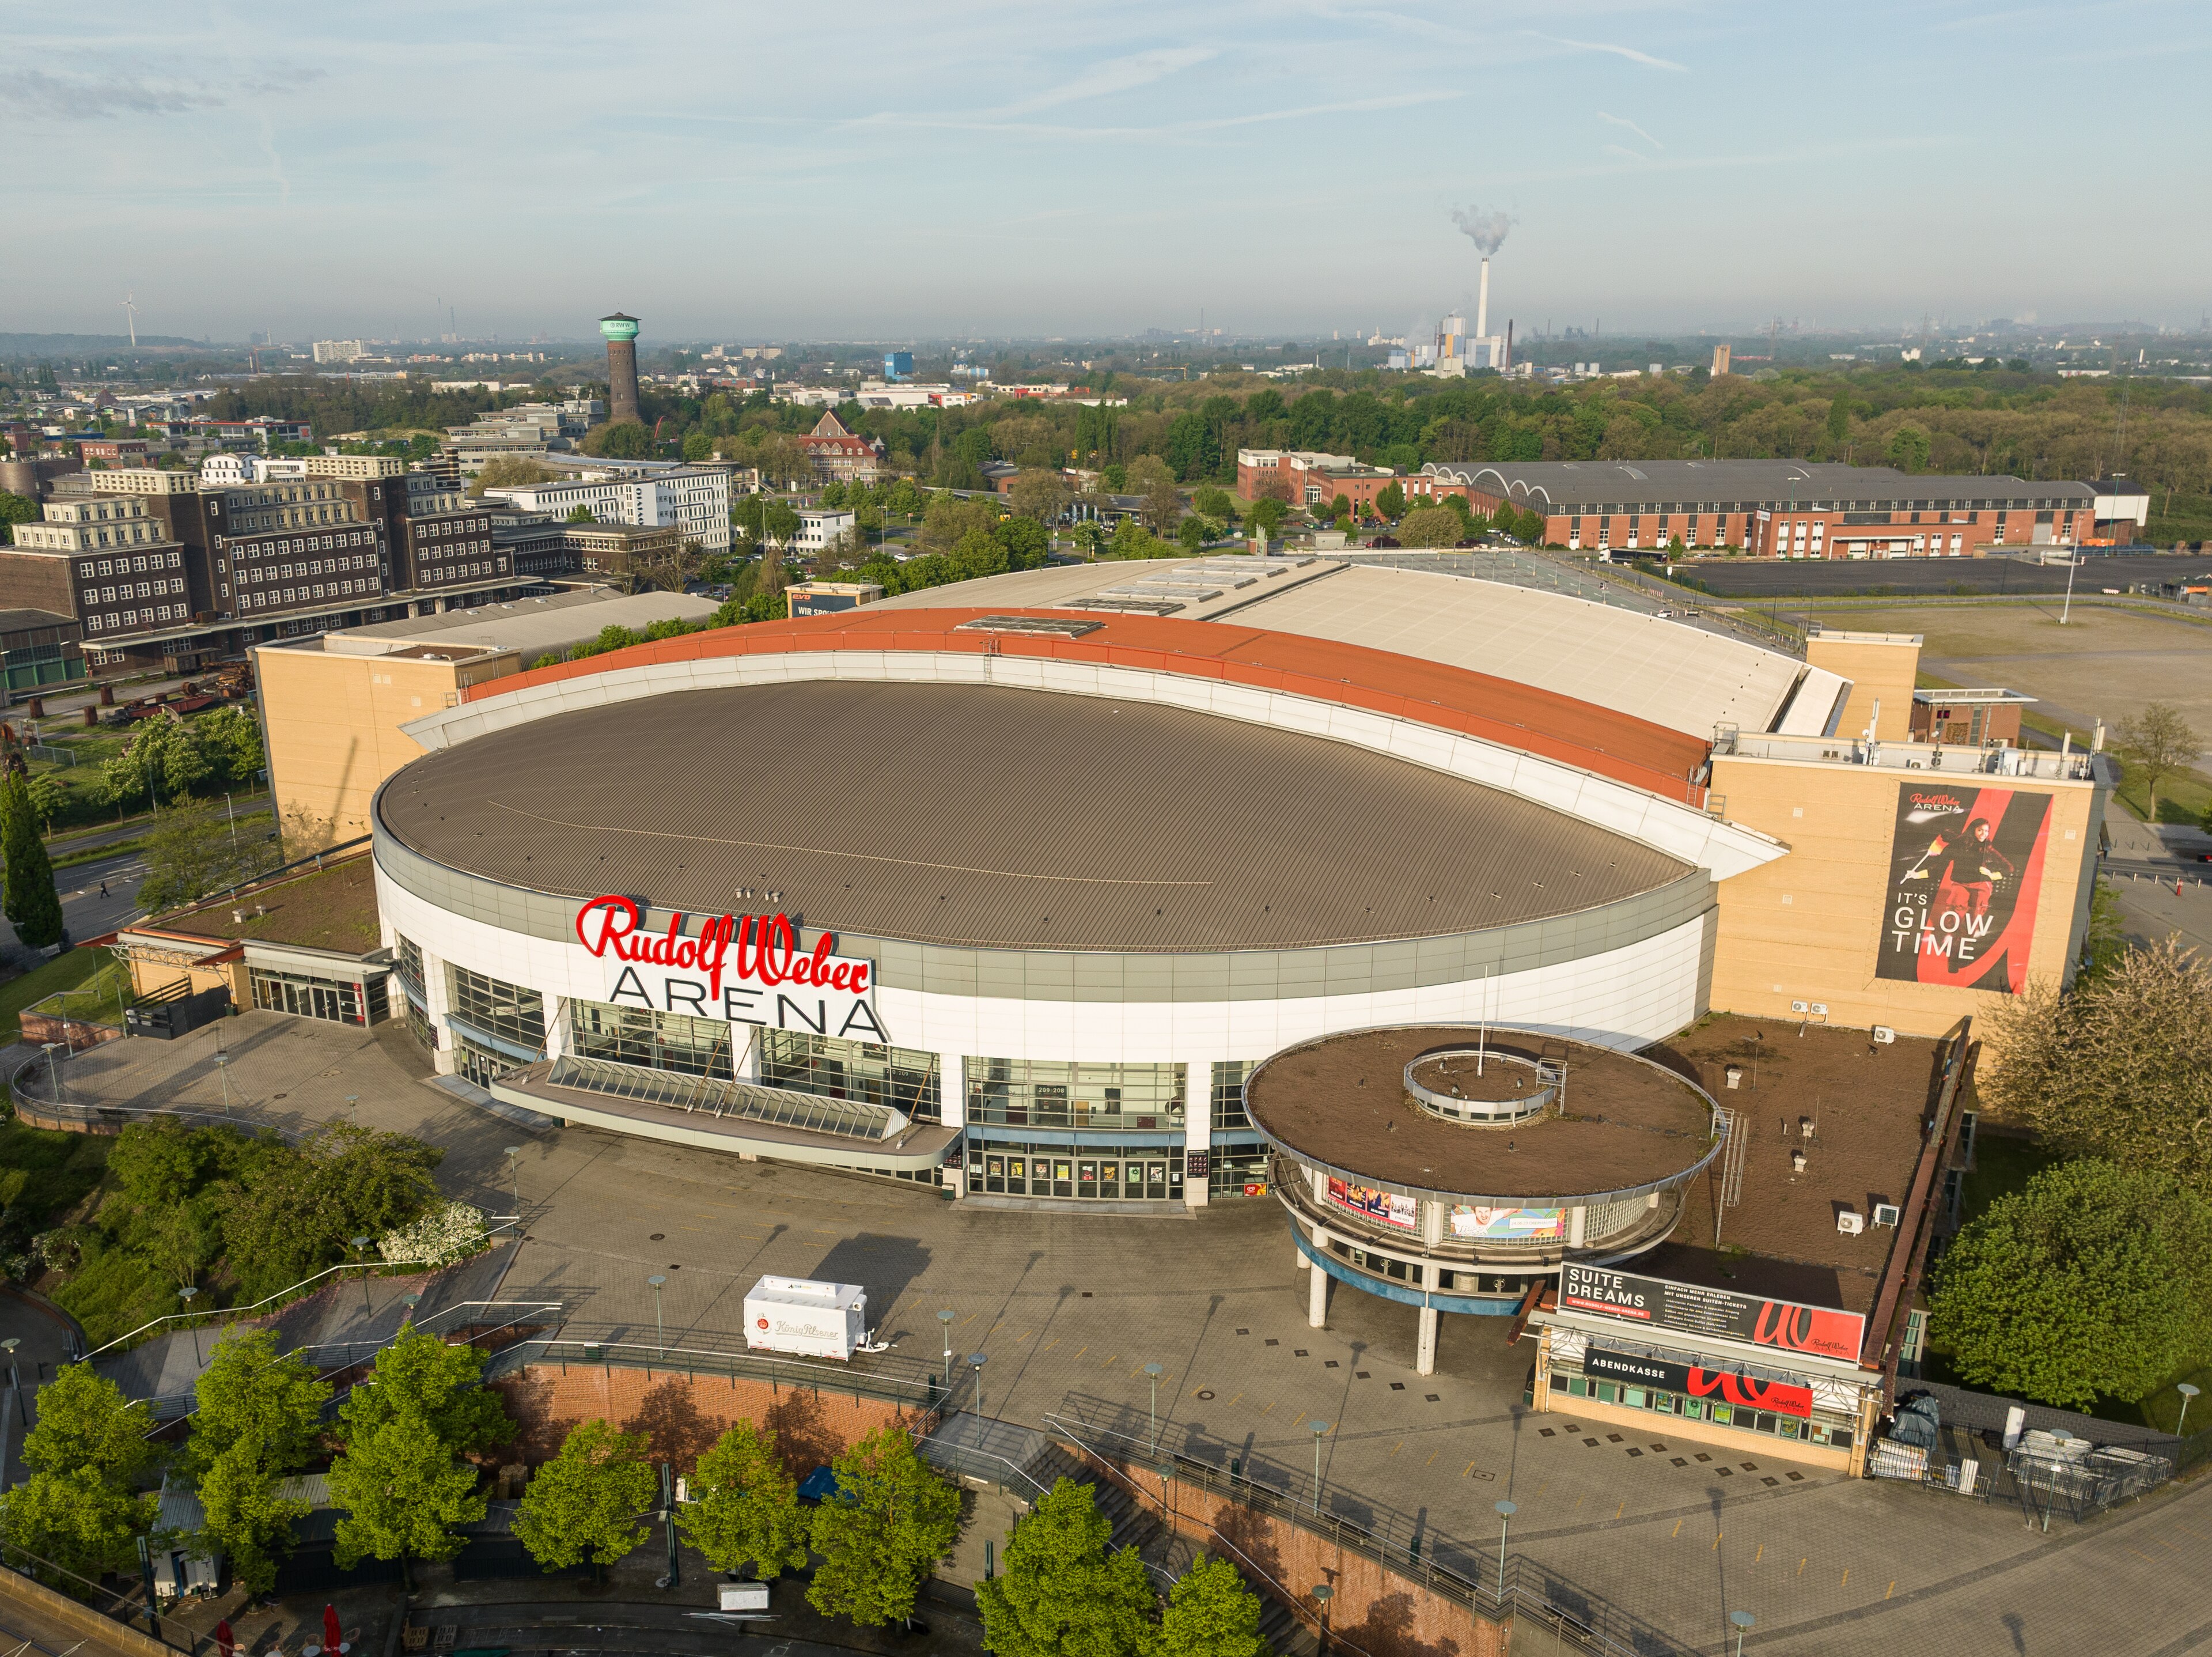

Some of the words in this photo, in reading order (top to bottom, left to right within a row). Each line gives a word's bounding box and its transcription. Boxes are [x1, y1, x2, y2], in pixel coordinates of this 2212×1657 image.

[798, 606, 812, 616] WIR
[1910, 793, 1938, 806] Rudolf
[1937, 794, 1960, 805] Weber
[1914, 803, 1961, 812] ARENA
[1897, 892, 1927, 905] IT'S
[1895, 907, 1994, 936] GLOW
[575, 894, 733, 1001] Rudolf
[737, 913, 870, 994] Weber
[1892, 930, 1977, 960] TIME
[609, 966, 889, 1044] ARENA
[1569, 1268, 1623, 1289] SUITE
[1568, 1283, 1645, 1307] DREAMS
[1665, 1285, 1688, 1293] EINFACH
[1571, 1299, 1645, 1316] WWW.RUDOLF-WEBER-ARENA.DE
[1676, 1292, 1700, 1302] UNSEREN
[1702, 1296, 1747, 1309] SUITEN-TICKETS
[775, 1320, 803, 1336] König
[803, 1324, 839, 1338] Pilsener
[1811, 1338, 1832, 1349] Rudolf
[1814, 1346, 1850, 1356] ARENA
[1592, 1358, 1665, 1379] ABENDKASSE
[1774, 1404, 1806, 1413] ARENA
